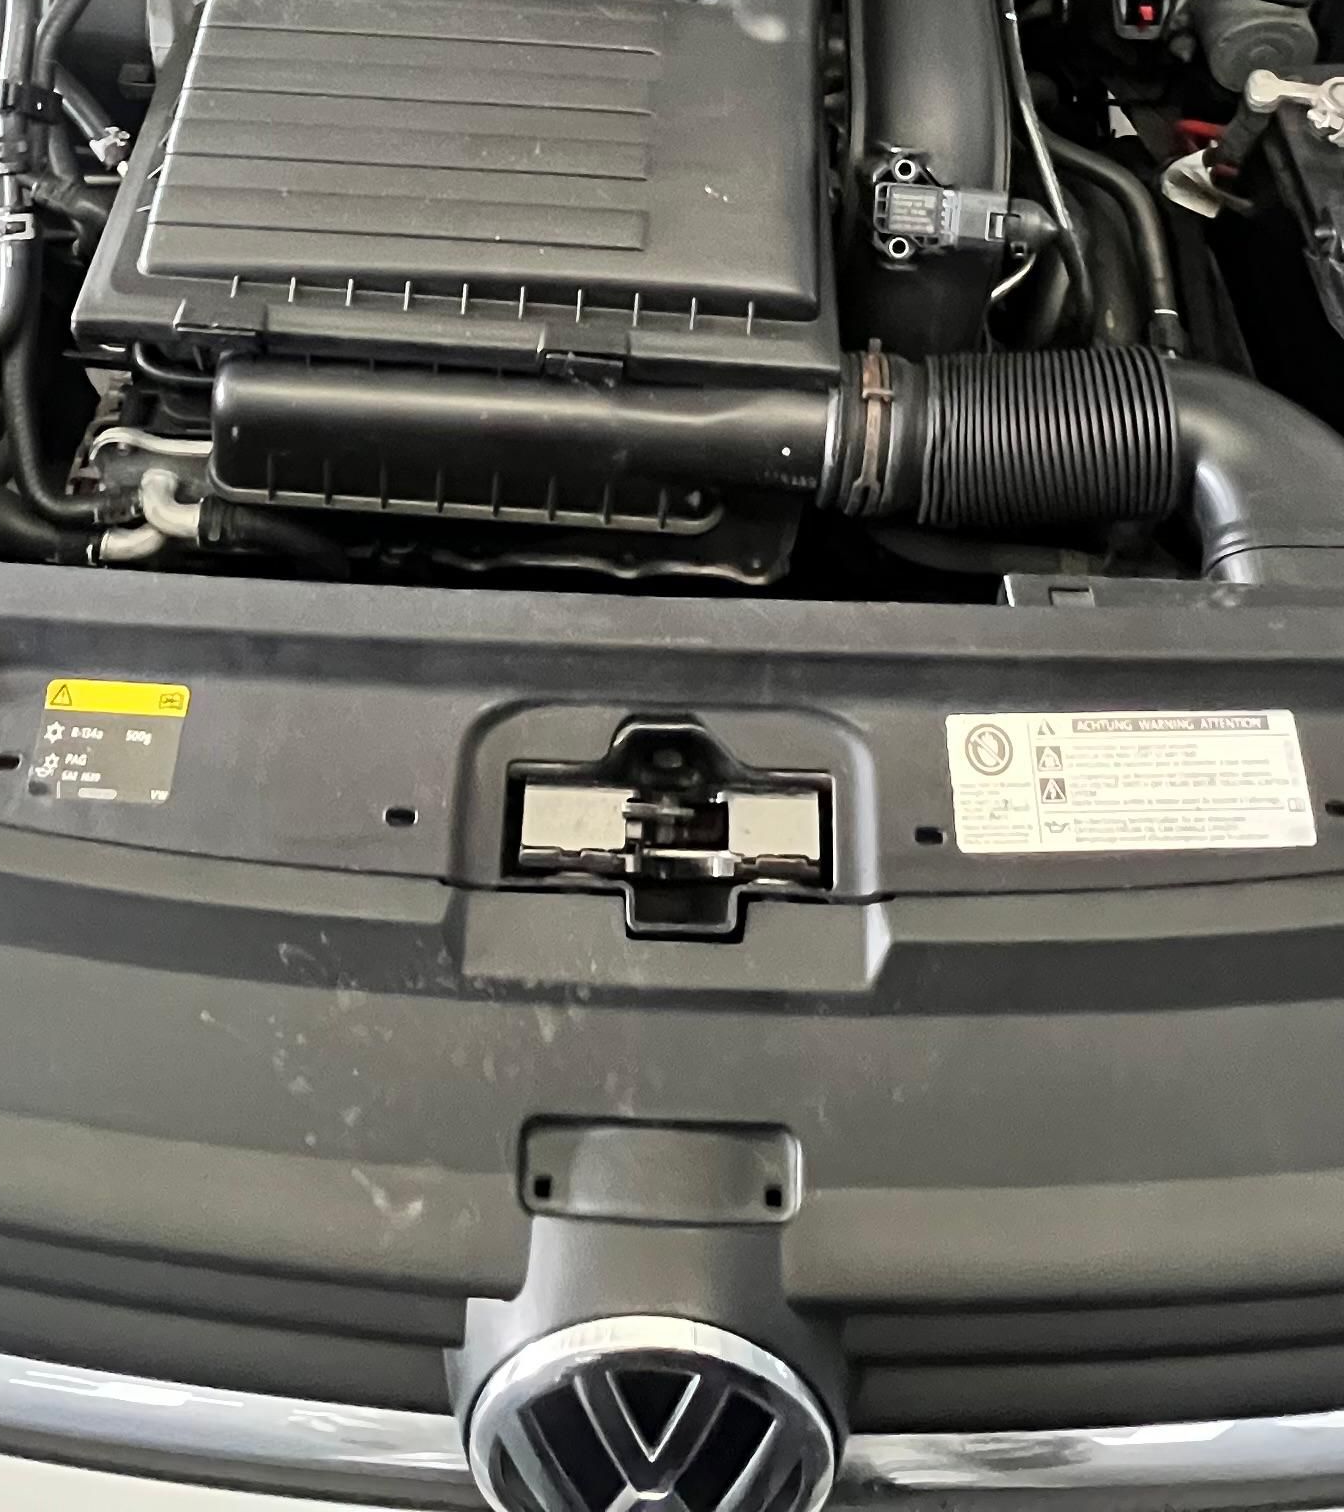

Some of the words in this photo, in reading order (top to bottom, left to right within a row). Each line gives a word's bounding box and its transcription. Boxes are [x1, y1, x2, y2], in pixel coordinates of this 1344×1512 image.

[1076, 719, 1133, 732] ACHTUNG
[1138, 718, 1195, 731] WARNING
[1200, 716, 1262, 730] ATTENTION
[64, 753, 88, 766] PAG
